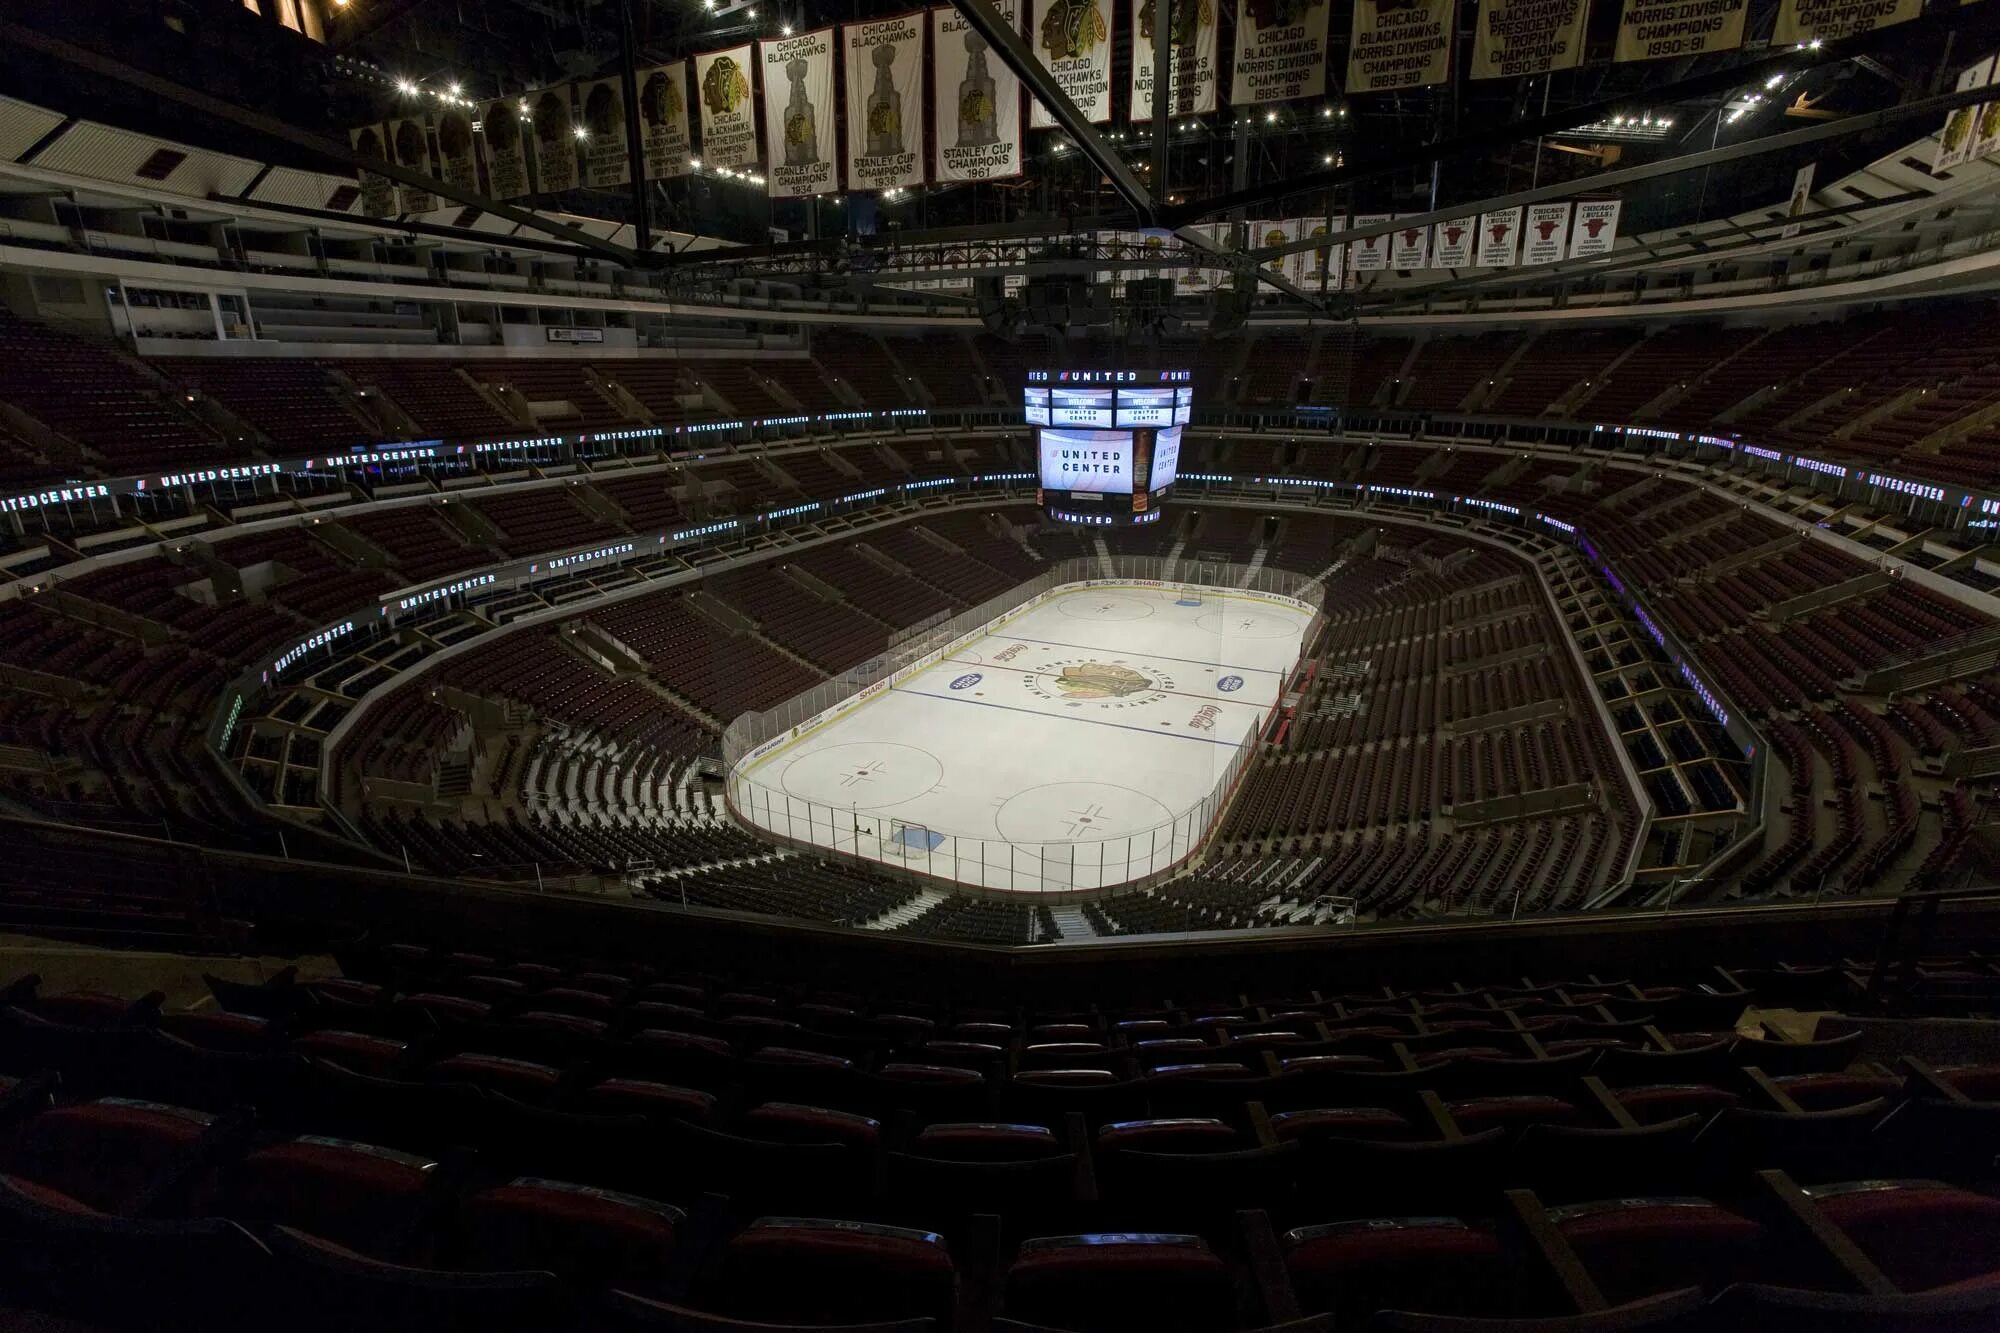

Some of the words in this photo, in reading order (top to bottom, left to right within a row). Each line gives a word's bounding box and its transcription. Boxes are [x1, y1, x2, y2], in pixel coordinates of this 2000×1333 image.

[1376, 9, 1429, 28] CHICAGO
[1489, 0, 1578, 24] BLACKHAWKS
[1624, 7, 1674, 26] NORRIS
[1679, 0, 1742, 19] DIVISION
[1800, 0, 1896, 26] CHAMPIONS
[862, 20, 905, 36] CHICAGO
[1258, 26, 1305, 45] CHICAGO
[1360, 22, 1441, 45] BLACKHAWKS
[1637, 17, 1723, 41] CHAMPIONS
[777, 35, 816, 52] CHICAGO
[852, 28, 917, 48] BLACKHAWKS
[1503, 31, 1557, 49] TROPHY
[1648, 36, 1705, 56] 1990-91
[768, 43, 826, 63] BLACKHAWKS
[1244, 39, 1318, 60] BLACKHAWKS
[1352, 43, 1393, 61] NORRIS
[1397, 36, 1447, 56] DIVISION
[1490, 41, 1567, 63] CHAMPIONS
[1051, 58, 1091, 73] CHICAGO
[1237, 59, 1275, 74] NORRIS
[1277, 52, 1322, 70] DIVISION
[1363, 54, 1432, 75] CHAMPIONS
[1501, 57, 1551, 75] 1990-91
[1172, 69, 1213, 87] DIVISION
[1248, 69, 1310, 87] CHAMPIONS
[1370, 71, 1420, 89] 1989-90
[1070, 81, 1108, 97] DIVISION
[714, 112, 741, 126] CHICAGO
[707, 122, 749, 137] BLACKHAWKS
[728, 130, 754, 145] DIVISION
[711, 142, 747, 156] CHAMPIONS
[943, 147, 988, 159] STANLEY
[992, 143, 1013, 155] CUP
[774, 165, 809, 177] STANLEY
[813, 162, 831, 173] CUP
[854, 156, 893, 168] STANLEY
[896, 153, 916, 165] CUP
[948, 154, 1009, 169] CHAMPIONS
[778, 173, 828, 186] CHAMPIONS
[858, 163, 913, 178] CHAMPIONS
[968, 167, 990, 178] 1961
[792, 184, 812, 195] 1934
[874, 176, 897, 187] 1938
[1486, 210, 1517, 218] CHICAGO
[1533, 207, 1565, 215] CHICAGO
[1072, 372, 1137, 381] UNITED
[594, 430, 630, 441] UNITED
[631, 428, 663, 438] CENTER
[475, 441, 520, 452] UNITED
[522, 437, 564, 448] CENTER
[327, 453, 379, 467] UNITED
[382, 448, 436, 461] CENTER
[1062, 450, 1120, 461] UNITED
[160, 469, 216, 487] UNITED
[220, 463, 281, 479] CENTER
[1062, 463, 1120, 474] CENTER
[1795, 457, 1819, 470] UNITED
[1819, 462, 1847, 477] CENTER
[1268, 477, 1300, 485] UNITED
[1301, 480, 1334, 488] CENTER
[1869, 474, 1903, 491] UNITED
[1903, 480, 1945, 501] CENTER
[40, 485, 109, 505] CENTER
[1370, 485, 1402, 495] UNITED
[1401, 489, 1434, 499] CENTER
[768, 508, 795, 520] UNITED
[795, 502, 820, 513] CENTER
[1064, 514, 1112, 524] UNITED
[673, 526, 706, 541] UNITED
[707, 520, 738, 533] CENTER
[549, 553, 592, 569] UNITED
[594, 543, 633, 558] CENTER
[400, 588, 448, 609] UNITED
[449, 574, 496, 594] CENTER
[274, 642, 307, 673] UNITED
[308, 621, 353, 649] CENTER
[859, 681, 886, 701] SHARP
[753, 746, 767, 758] BUD
[767, 736, 785, 750] LIGHT
